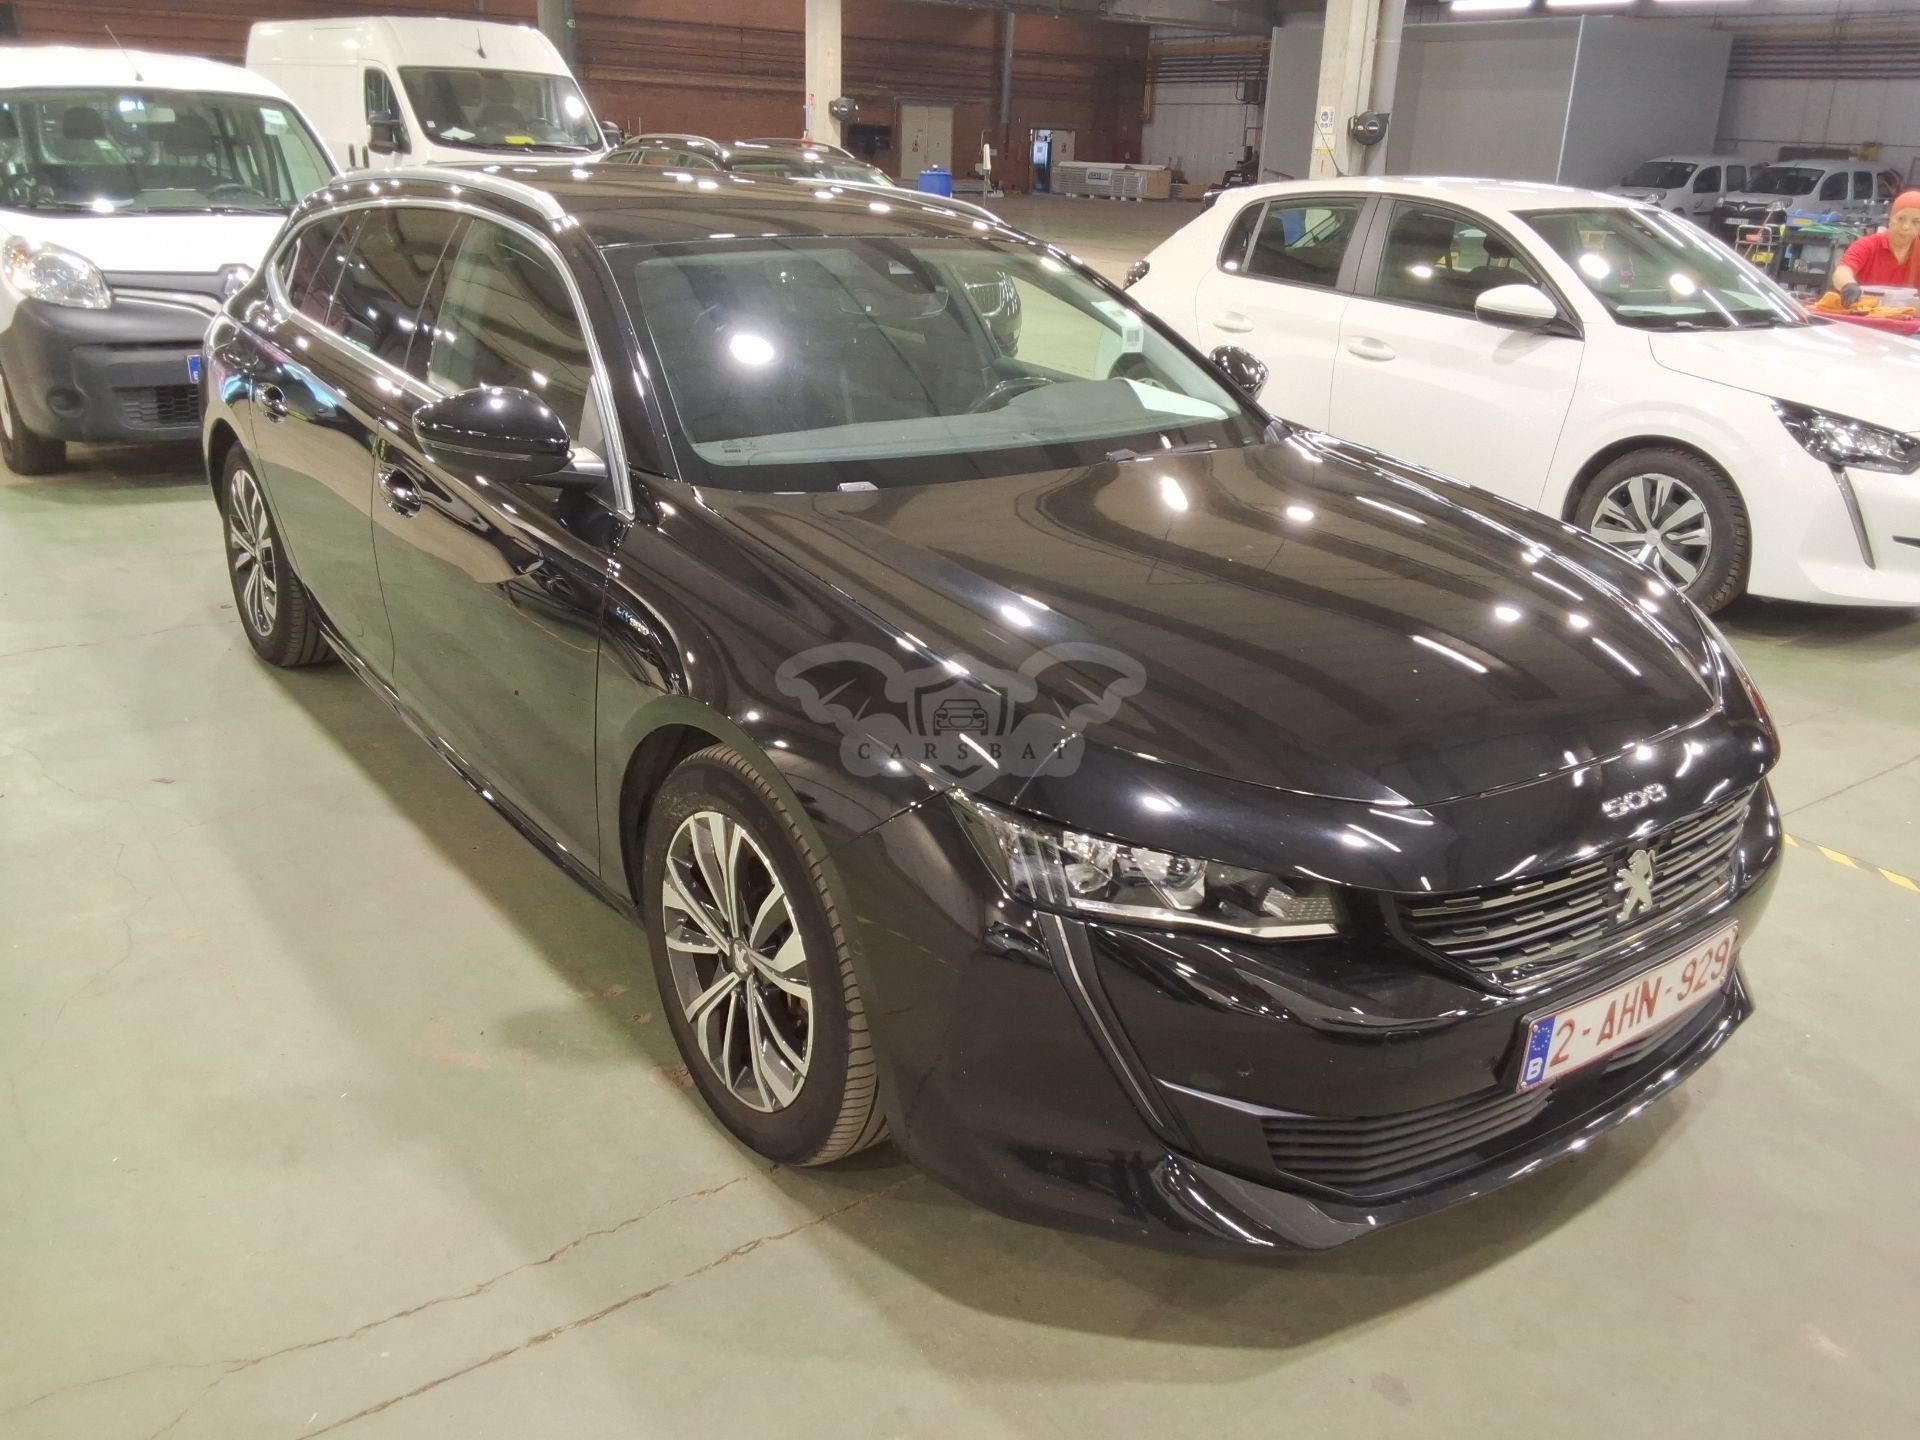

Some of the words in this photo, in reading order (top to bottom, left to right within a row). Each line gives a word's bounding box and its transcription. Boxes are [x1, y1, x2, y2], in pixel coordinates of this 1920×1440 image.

[1602, 783, 1668, 819] 508
[1549, 936, 1731, 1068] 2-AHN-929
[1527, 1057, 1544, 1082] B
